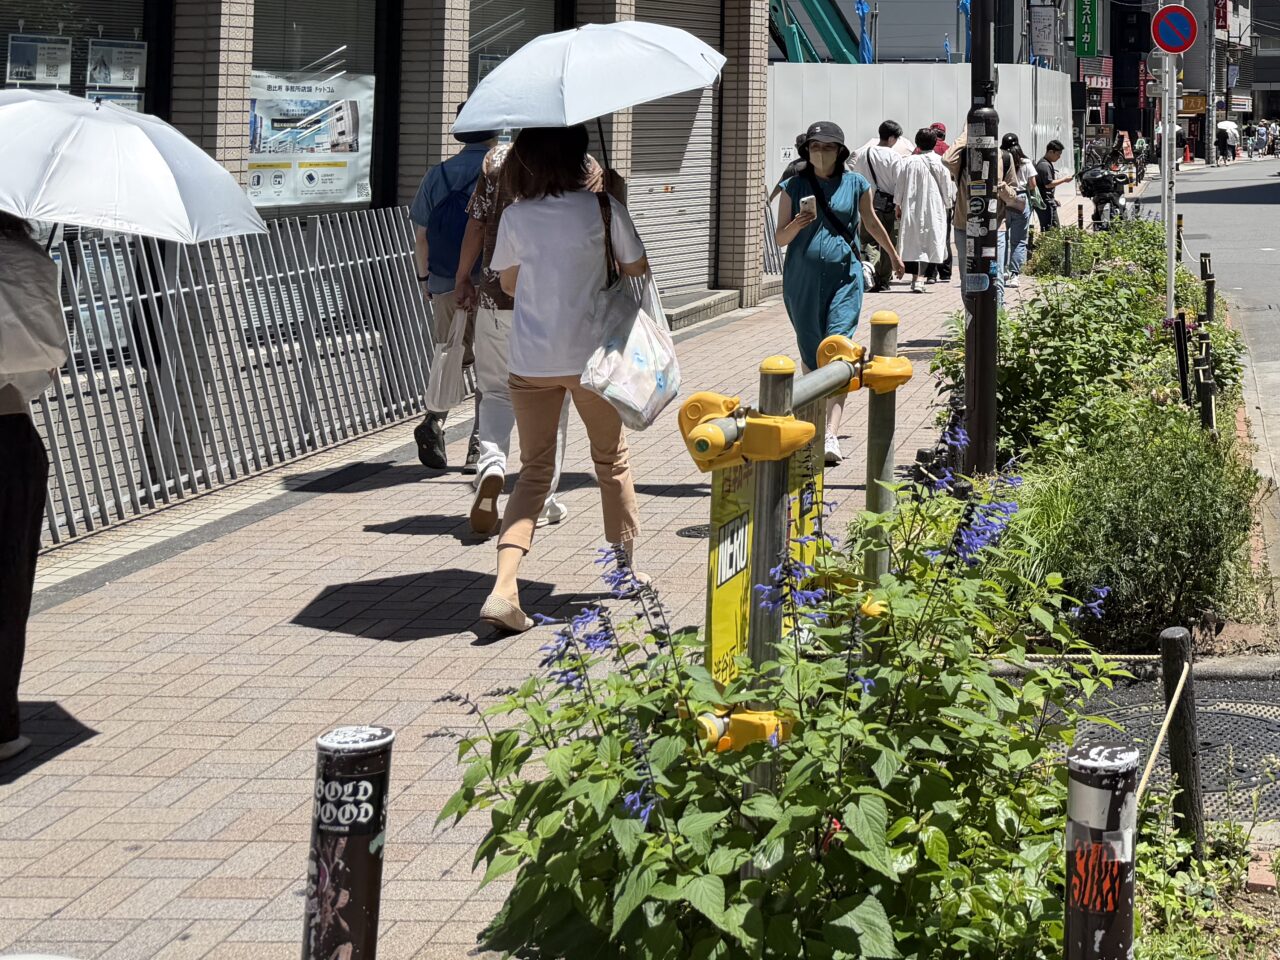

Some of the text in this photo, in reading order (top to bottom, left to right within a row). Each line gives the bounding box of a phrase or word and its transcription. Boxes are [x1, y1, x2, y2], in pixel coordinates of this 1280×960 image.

[1217, 0, 1226, 26] ゲーム
[716, 515, 749, 586] NERO
